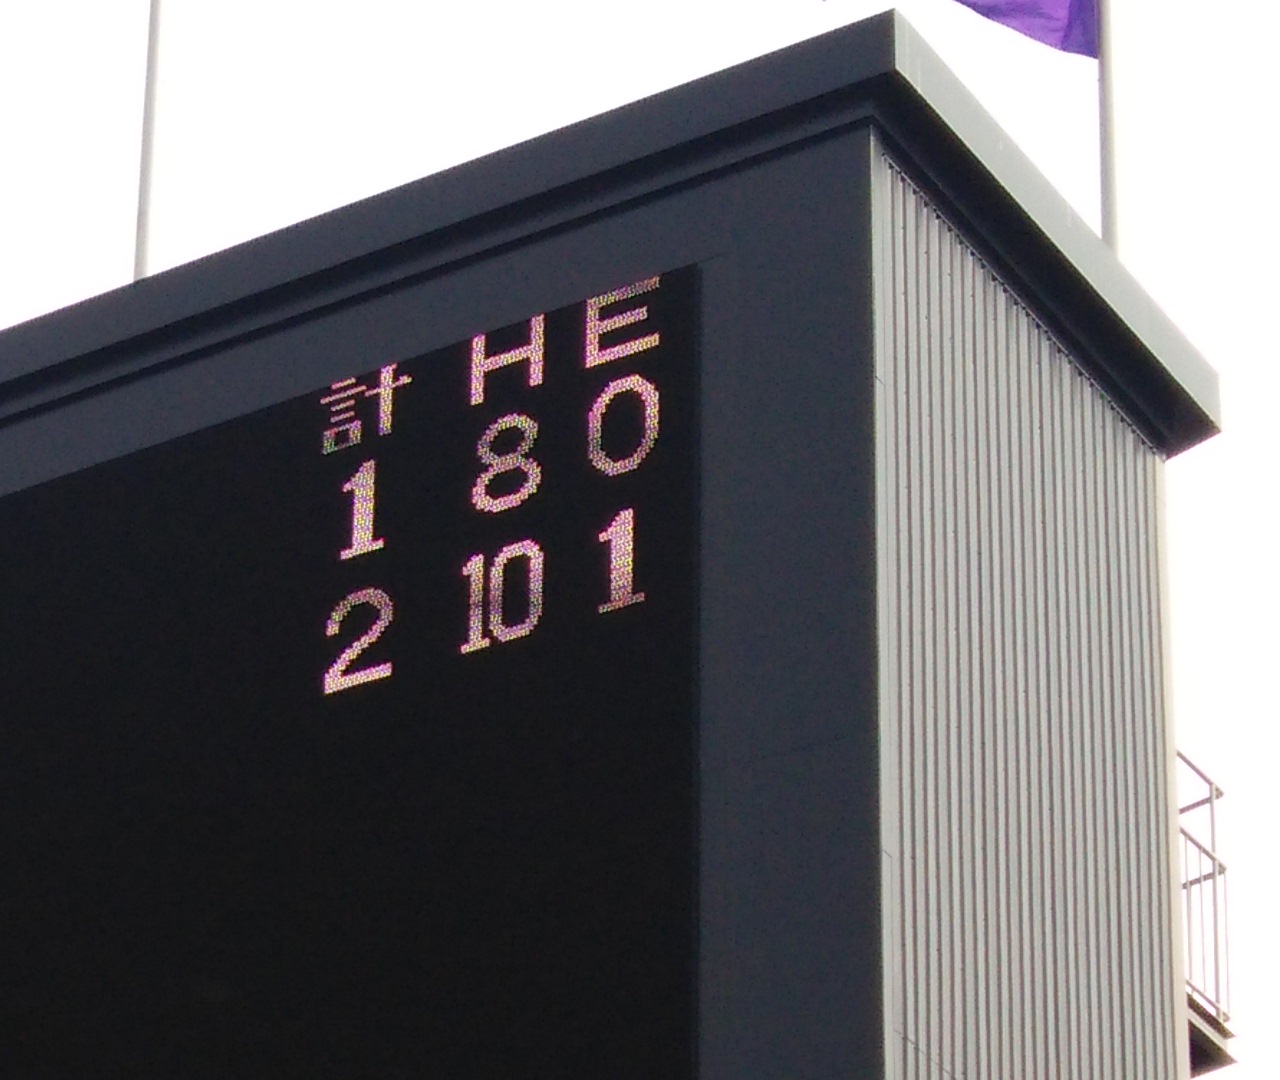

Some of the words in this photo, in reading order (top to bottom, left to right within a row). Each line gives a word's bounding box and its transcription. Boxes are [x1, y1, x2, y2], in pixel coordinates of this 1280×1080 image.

[319, 361, 414, 456] 計
[469, 312, 546, 407] H
[583, 275, 661, 370] E
[339, 458, 386, 561] 1
[470, 411, 543, 515] 8
[586, 372, 661, 478] 0
[322, 586, 394, 696] 2
[459, 538, 546, 656] 10
[597, 506, 646, 615] 1
